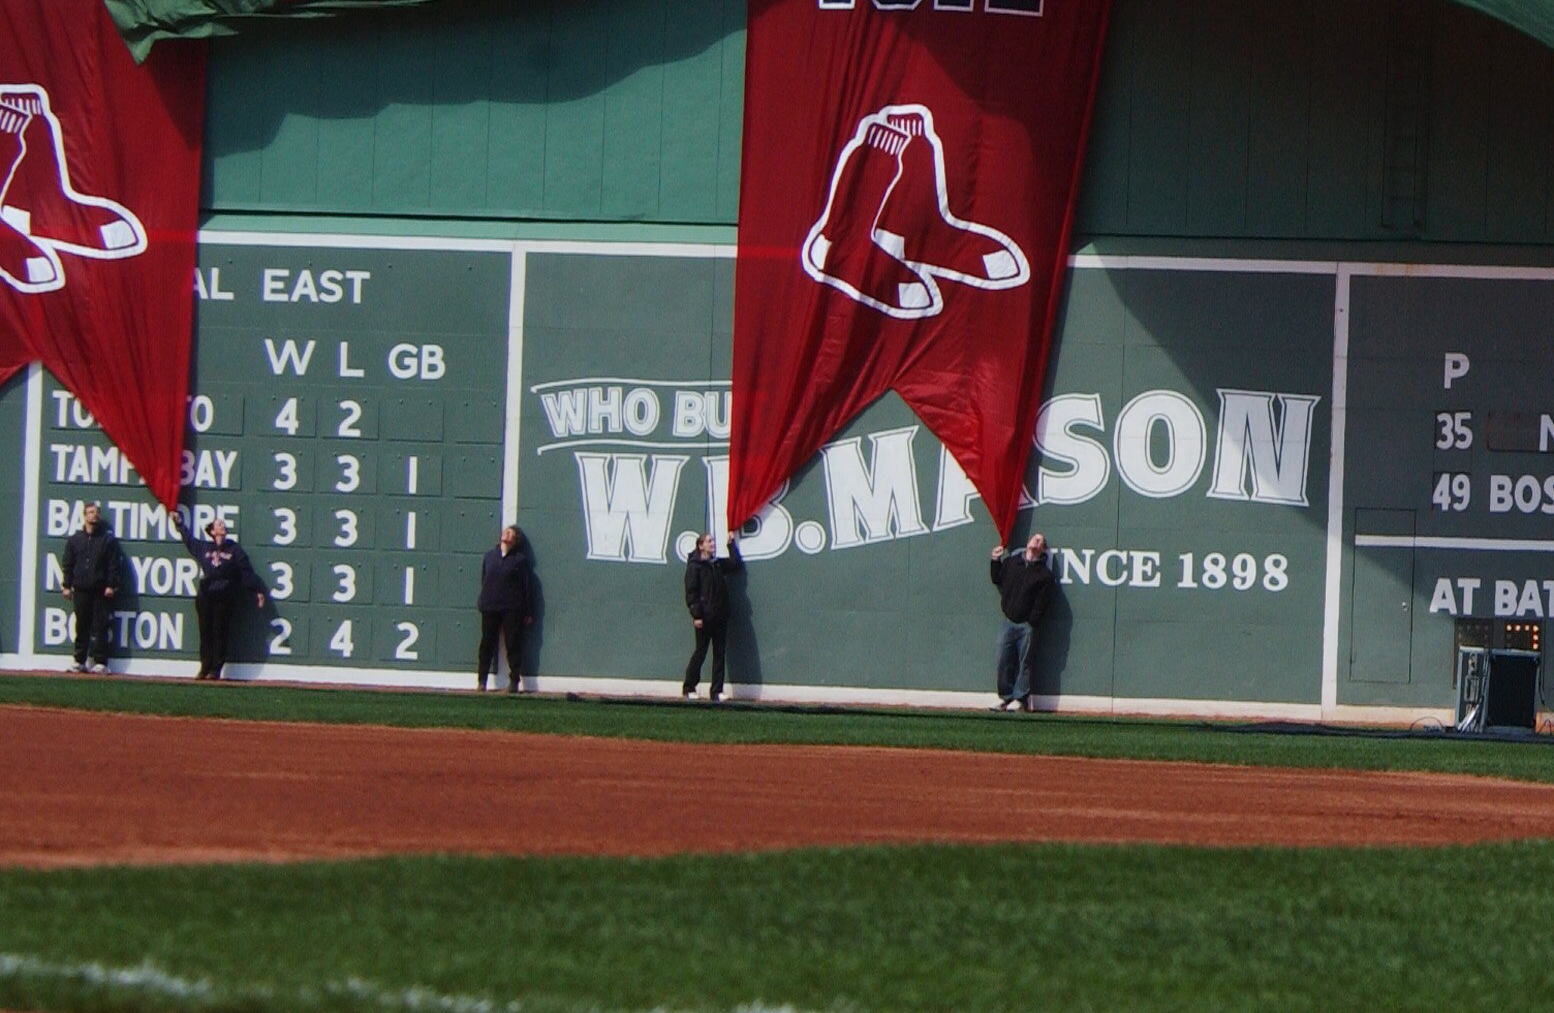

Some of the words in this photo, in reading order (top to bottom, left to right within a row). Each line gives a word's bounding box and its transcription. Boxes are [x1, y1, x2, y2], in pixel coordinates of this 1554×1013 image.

[264, 268, 370, 304] EAST
[264, 338, 316, 376] W
[339, 341, 365, 378] L
[387, 343, 446, 380] GB
[1443, 352, 1471, 389] P
[275, 397, 299, 436] 4
[338, 400, 362, 437] 2
[541, 386, 661, 438] WHO
[1436, 412, 1474, 450] 35
[273, 453, 297, 490] 3
[335, 455, 360, 492] 3
[409, 455, 418, 494] 1
[1432, 472, 1471, 512] 49
[273, 508, 297, 545] 3
[334, 509, 358, 547] 3
[407, 511, 416, 549] 1
[131, 556, 204, 596] YOR
[270, 562, 294, 600] 3
[332, 564, 356, 602] 3
[405, 566, 414, 605] 1
[1177, 552, 1289, 592] 1898
[1429, 577, 1481, 616] AT
[269, 617, 292, 655] 2
[330, 620, 354, 658] 4
[396, 622, 419, 660] 2
